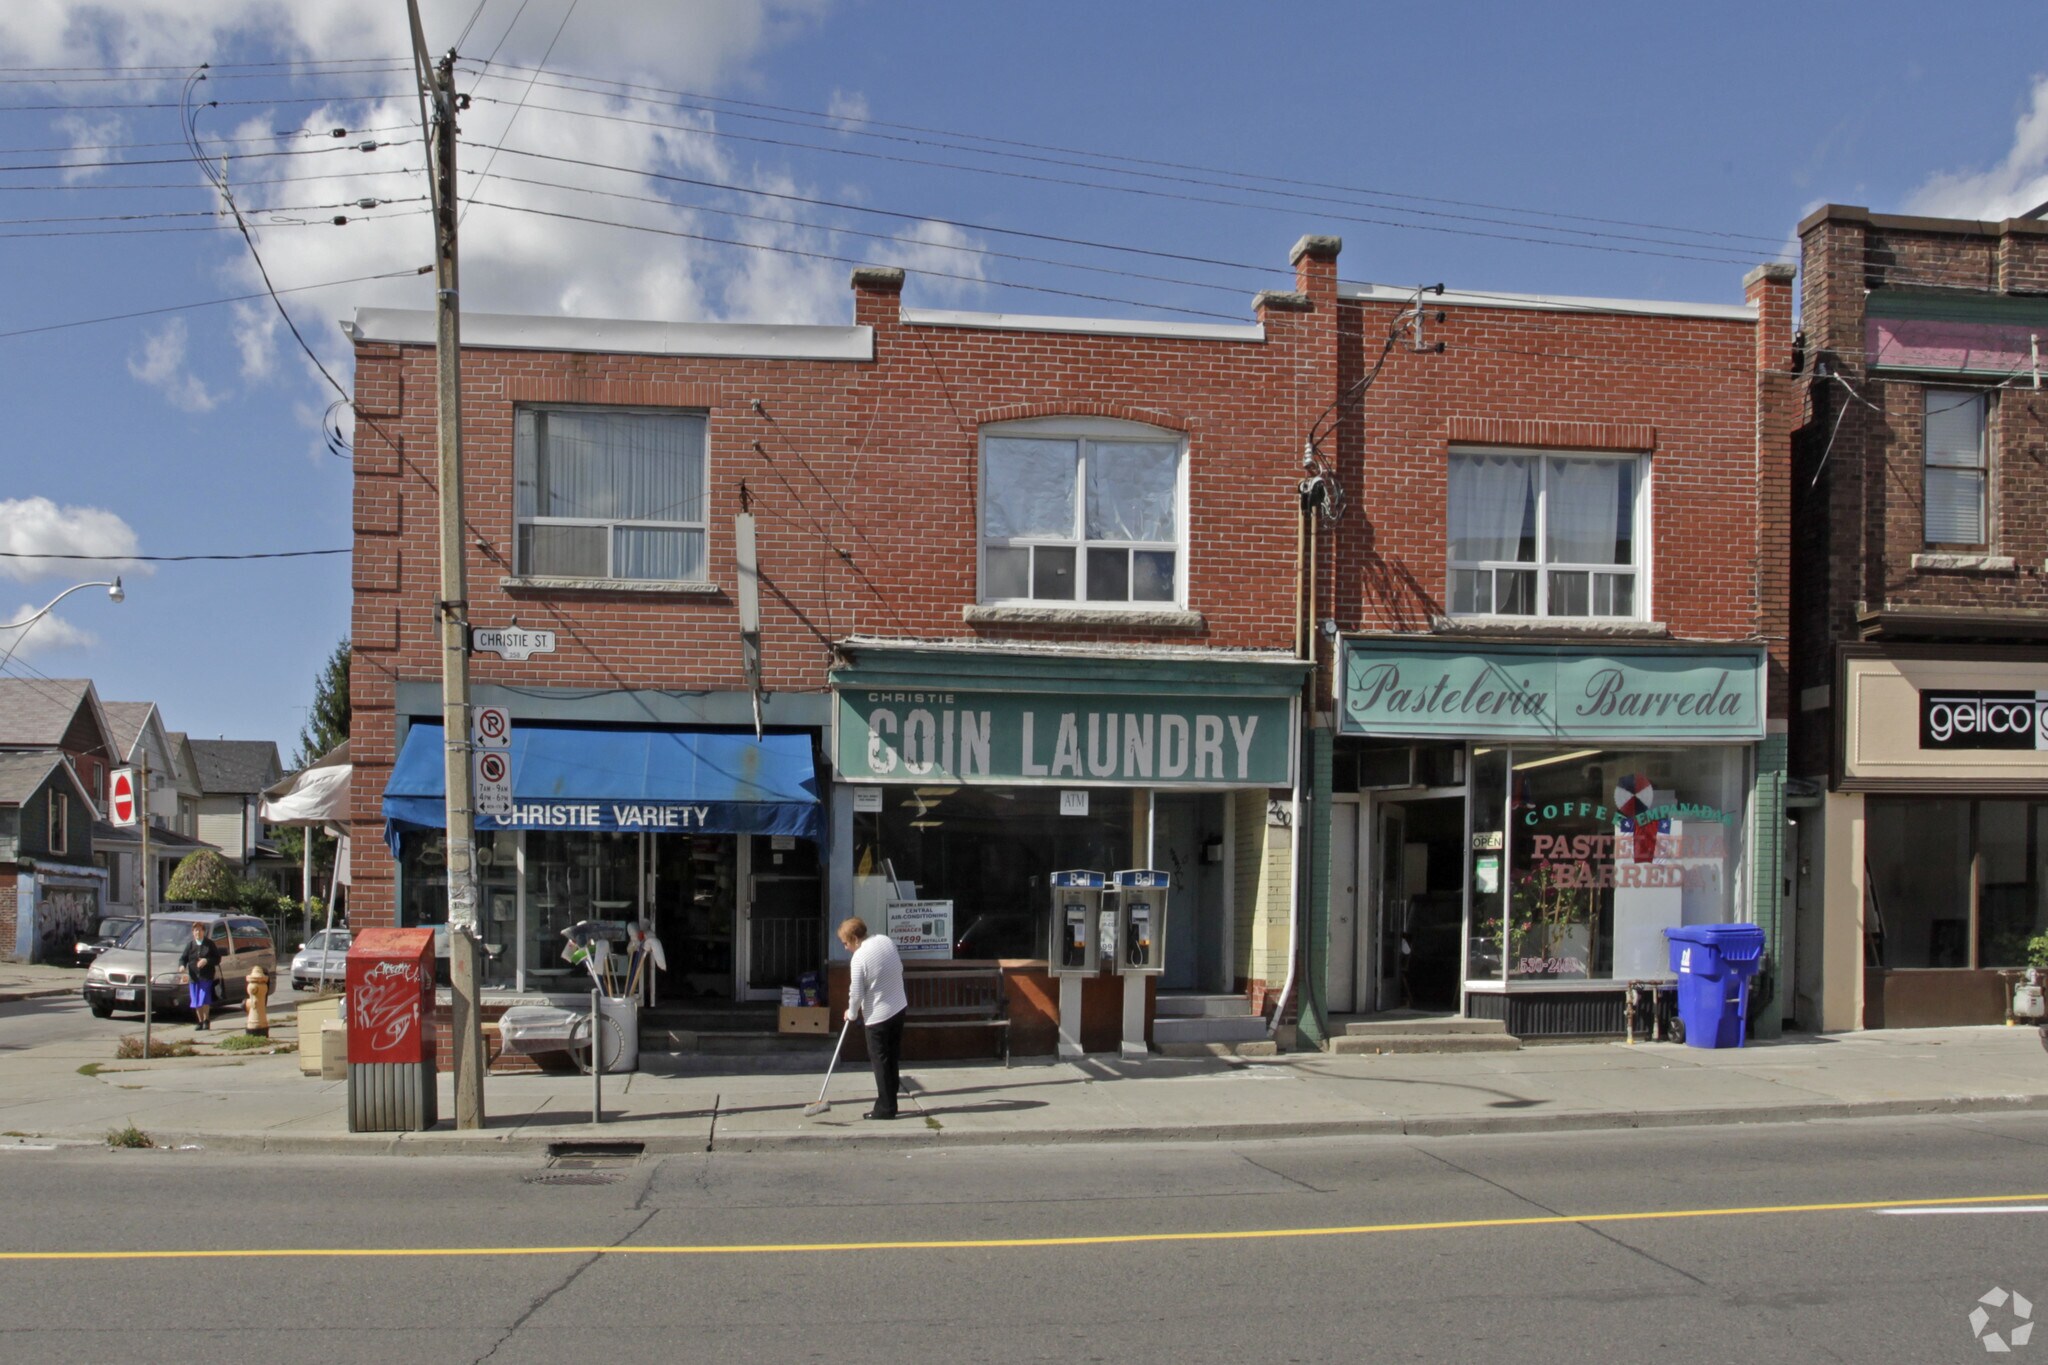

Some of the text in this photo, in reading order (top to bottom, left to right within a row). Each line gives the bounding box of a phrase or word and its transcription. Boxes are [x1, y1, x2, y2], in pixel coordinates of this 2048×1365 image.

[480, 633, 529, 647] CHRISTIE
[868, 692, 955, 704] CHRISTIE
[1351, 662, 1742, 717] Pasteleria Barreda
[1930, 698, 2030, 741] gelico
[868, 708, 1259, 778] COIN LAUNDRY
[1064, 793, 1085, 808] ATM
[495, 805, 709, 827] CHRISTIE VARIETY
[1268, 800, 1292, 826] 260
[1525, 802, 1628, 827] COFFEE
[1473, 837, 1501, 848] OPEN
[1531, 834, 1728, 860] PASTELERIA
[1070, 873, 1090, 886] Bell
[1135, 872, 1155, 886] Bell
[1552, 864, 1705, 890] BARREDA
